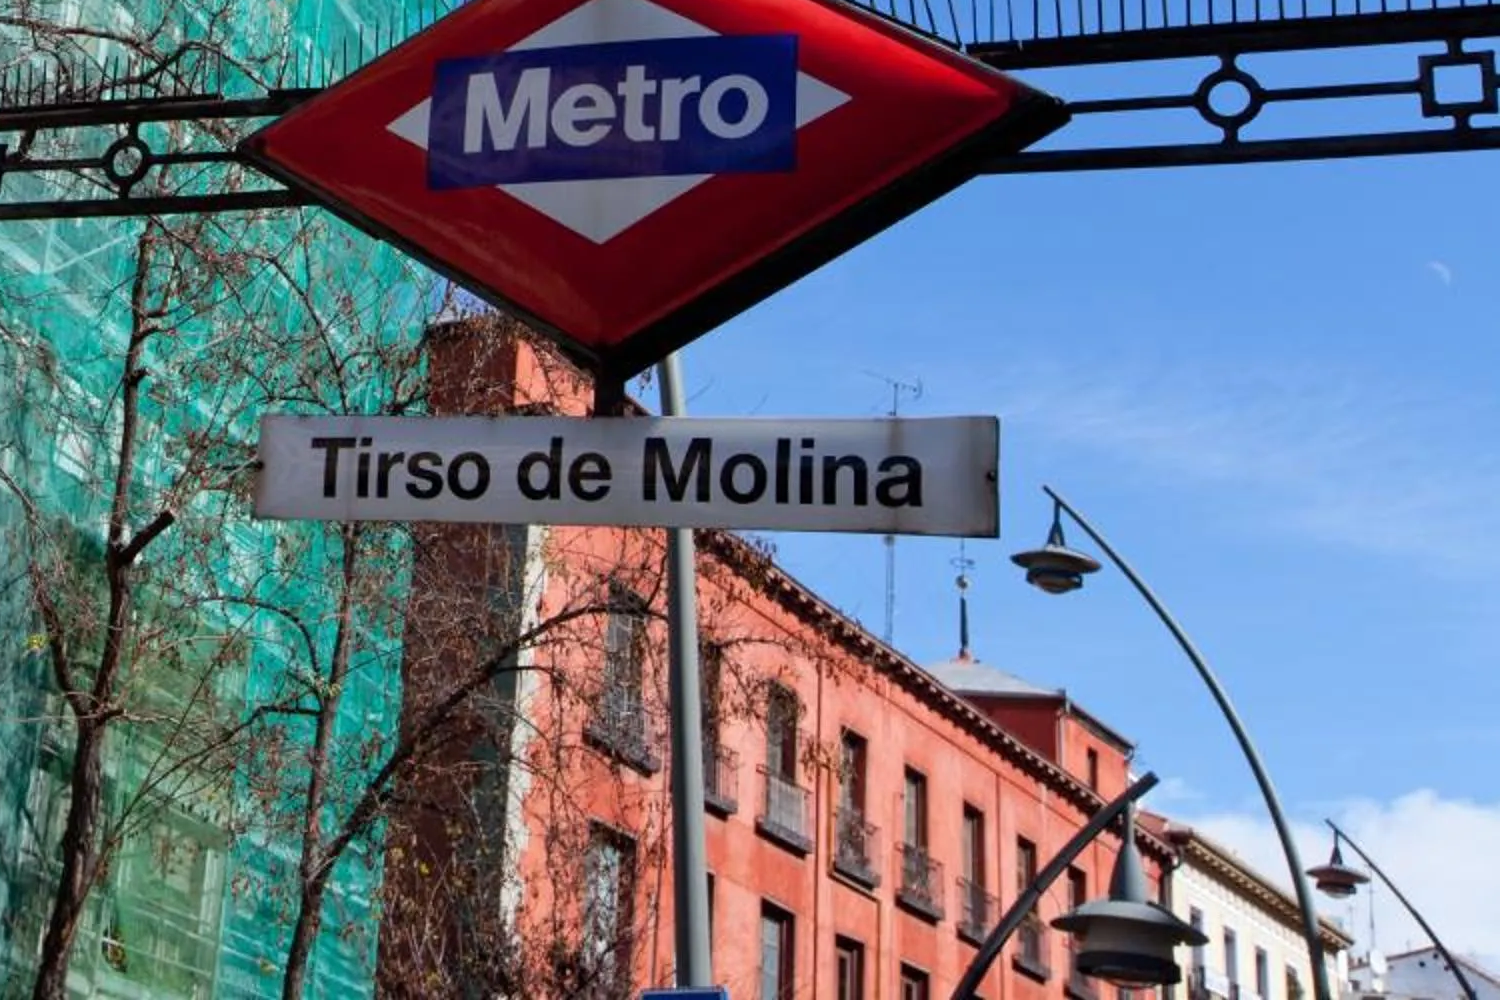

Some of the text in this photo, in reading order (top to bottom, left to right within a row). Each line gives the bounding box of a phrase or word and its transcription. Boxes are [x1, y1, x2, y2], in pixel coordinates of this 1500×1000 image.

[462, 65, 770, 154] Metro
[310, 436, 925, 508] Tirso de Molina
